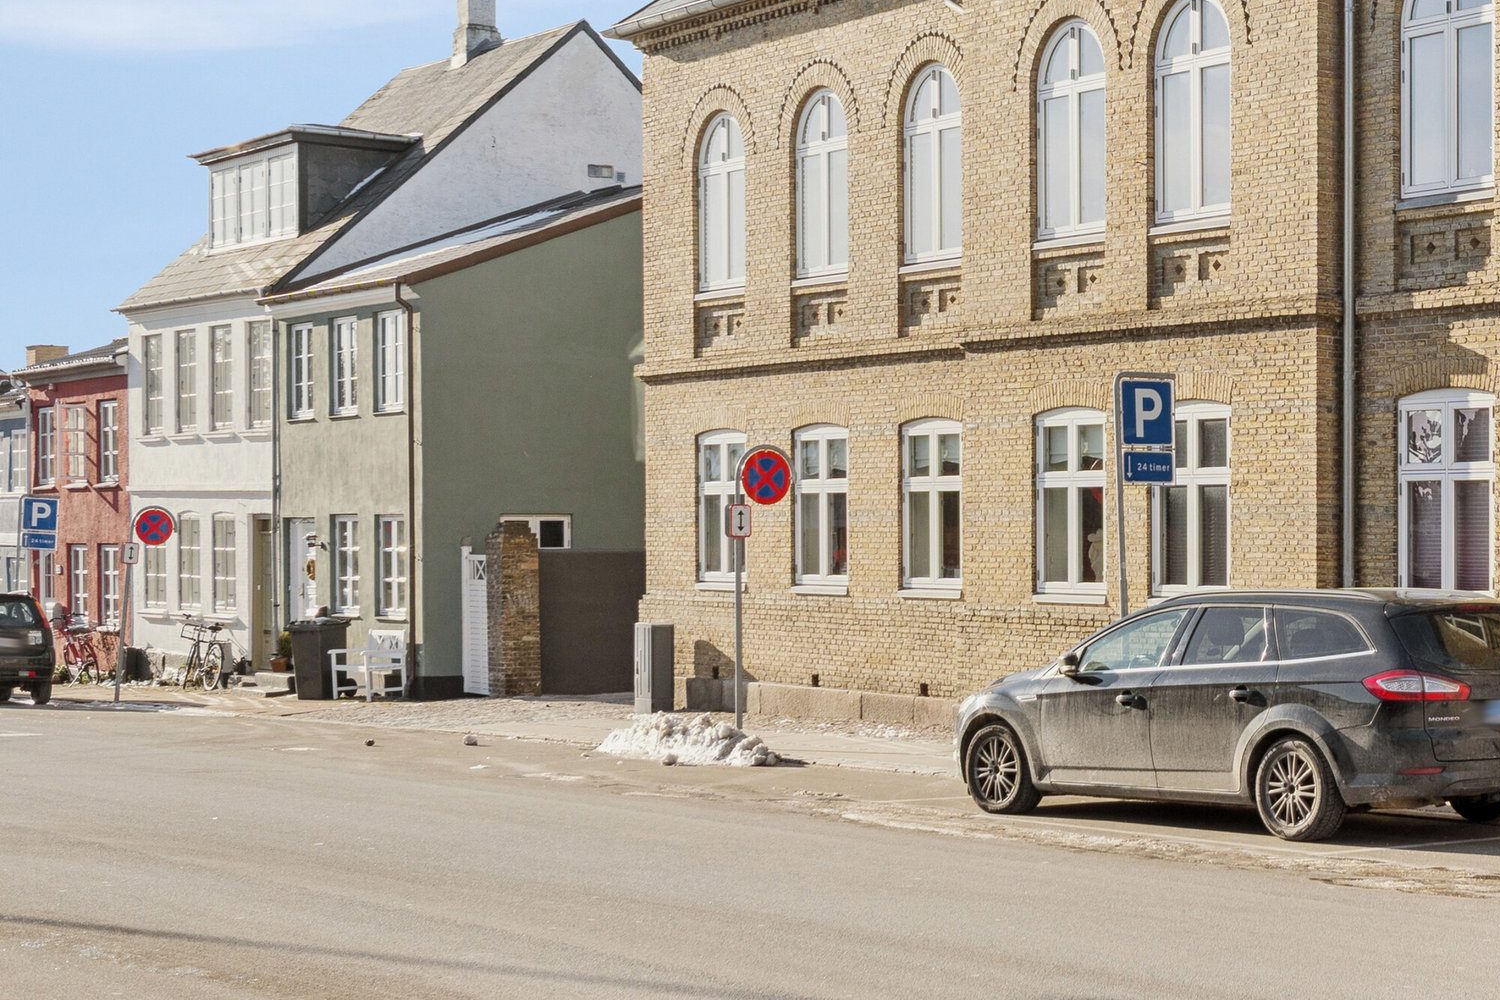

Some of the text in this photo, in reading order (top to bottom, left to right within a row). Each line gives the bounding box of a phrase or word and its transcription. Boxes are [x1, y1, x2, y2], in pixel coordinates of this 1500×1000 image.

[1134, 388, 1163, 438] P
[1137, 462, 1170, 471] 24 timer
[31, 501, 52, 527] P
